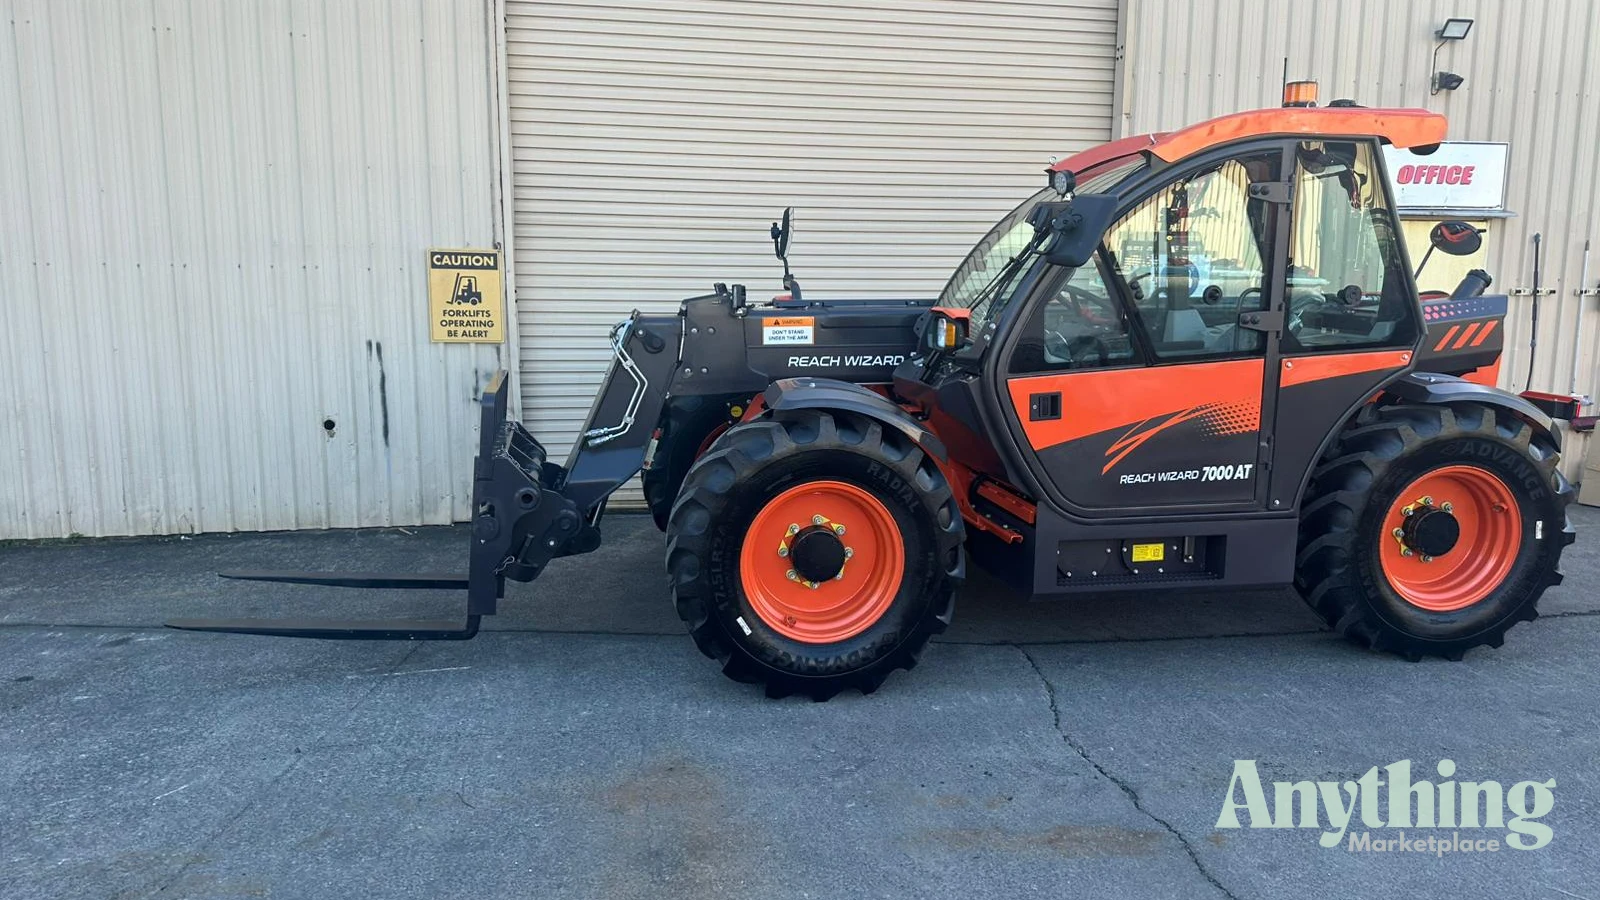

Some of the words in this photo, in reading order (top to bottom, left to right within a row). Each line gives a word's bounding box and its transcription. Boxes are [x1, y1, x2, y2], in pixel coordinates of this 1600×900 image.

[1396, 164, 1475, 185] OFFICE
[432, 254, 494, 267] CAUTION
[442, 309, 491, 318] FORKLIFTS
[440, 319, 494, 328] OPERATING
[447, 329, 458, 337] BE
[461, 329, 488, 338] ALERT
[787, 356, 841, 367] REACH
[844, 355, 905, 366] WIZARD
[1119, 473, 1156, 484] REACH
[1157, 470, 1199, 481] WIZARD
[1201, 464, 1234, 482] 7000
[1233, 463, 1253, 480] AT
[1463, 440, 1545, 501] ADVANCE
[867, 461, 920, 513] RADIAL
